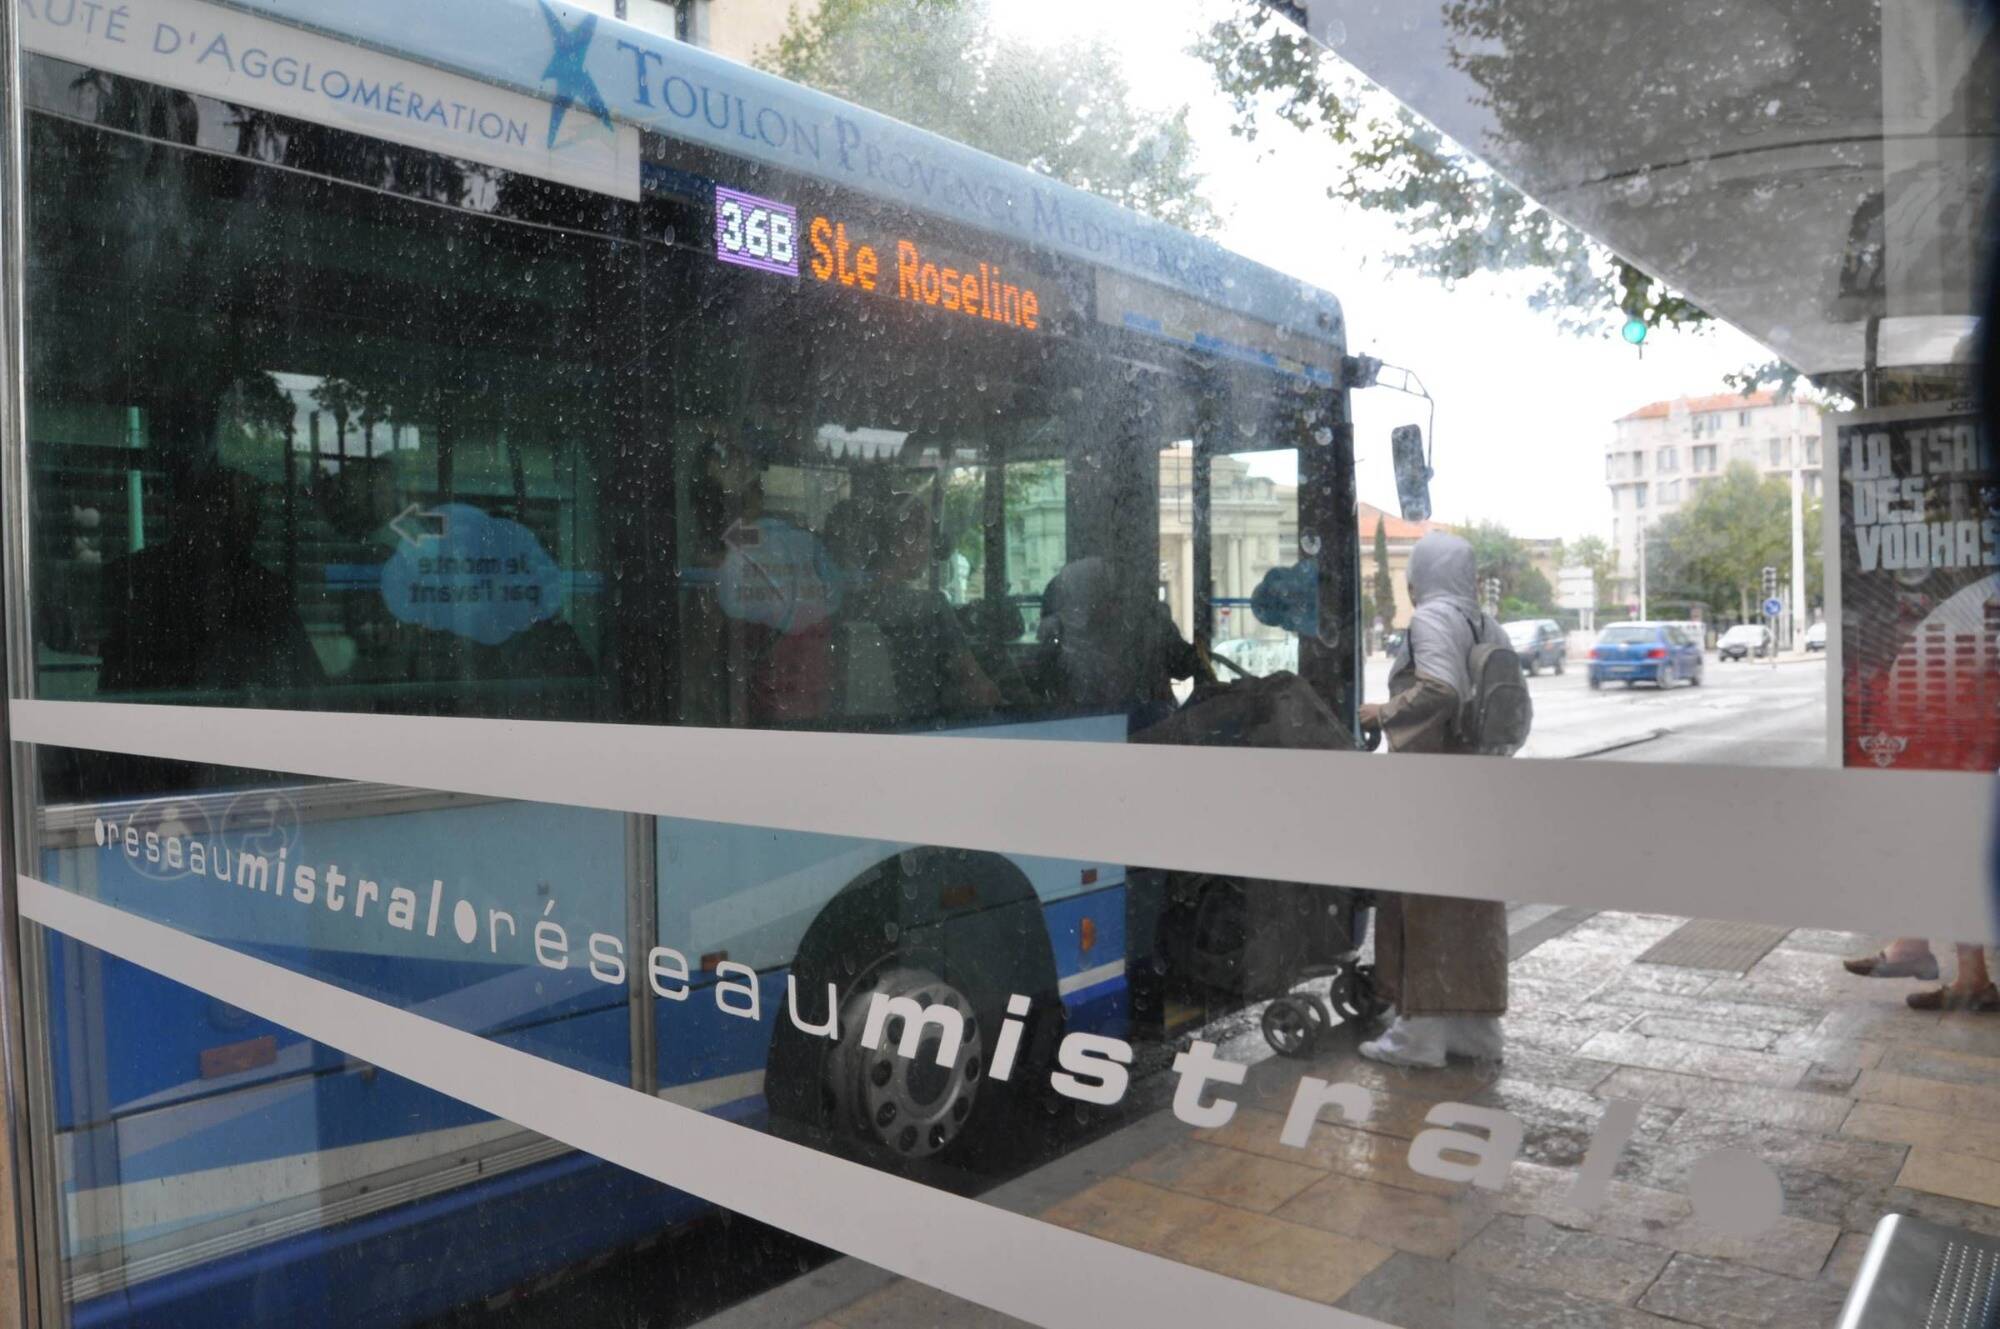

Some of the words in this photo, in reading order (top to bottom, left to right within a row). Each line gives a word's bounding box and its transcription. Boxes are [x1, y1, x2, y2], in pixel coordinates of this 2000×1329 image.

[153, 23, 528, 146] D'AGGLOMÉRATION
[617, 39, 820, 161] TOULON
[720, 201, 793, 263] 36B
[810, 216, 878, 291] Ste
[897, 240, 1039, 330] Roseline
[1850, 432, 1892, 480] LA
[1853, 476, 1925, 525] DES
